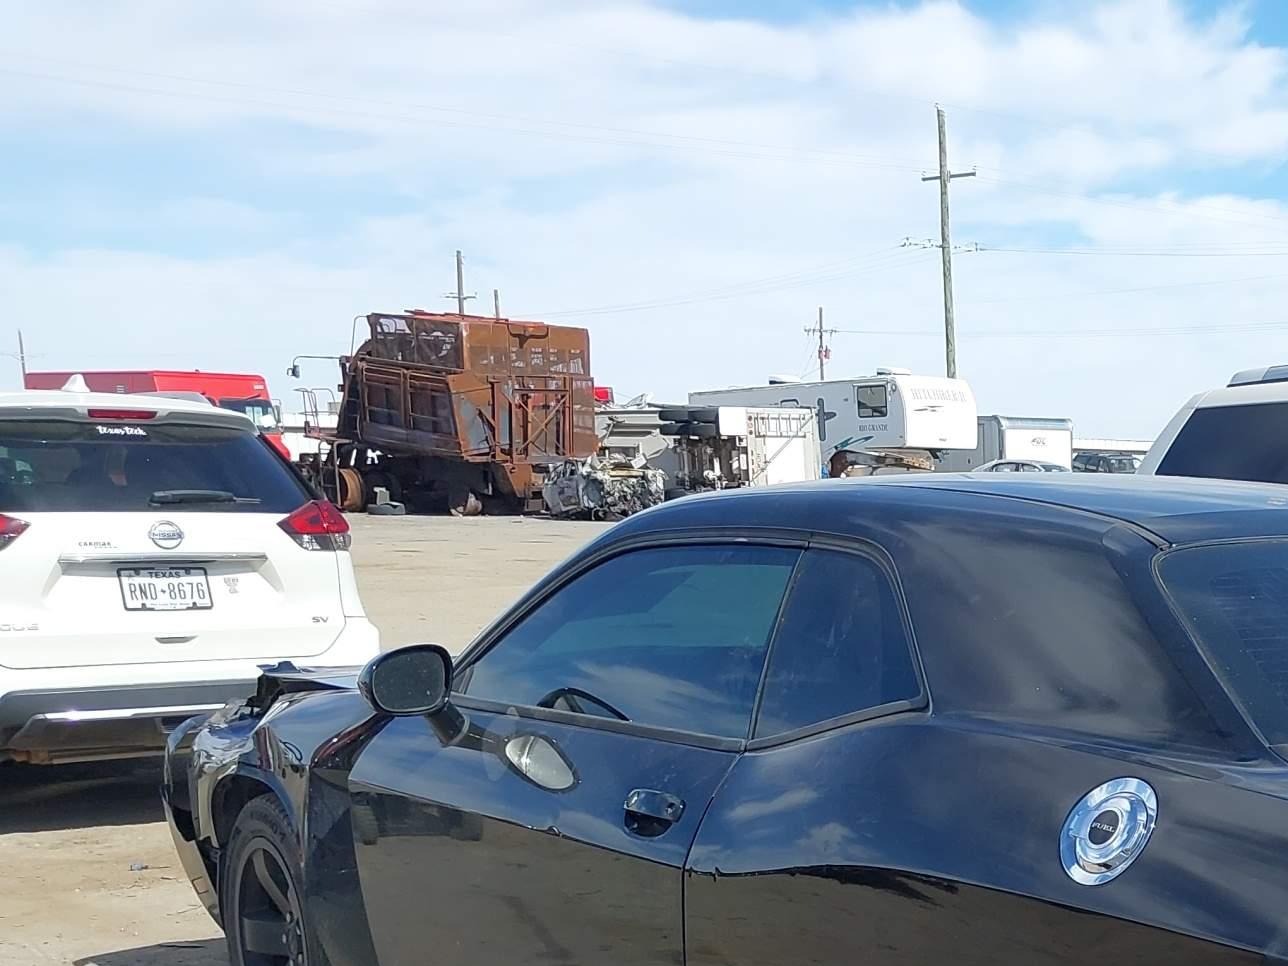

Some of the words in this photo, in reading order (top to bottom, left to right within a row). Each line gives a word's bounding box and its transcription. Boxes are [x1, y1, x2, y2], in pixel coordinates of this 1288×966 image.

[152, 531, 182, 539] NISSAN
[147, 571, 181, 579] TEXAS
[311, 616, 329, 624] SV
[1091, 822, 1115, 833] FUEL
